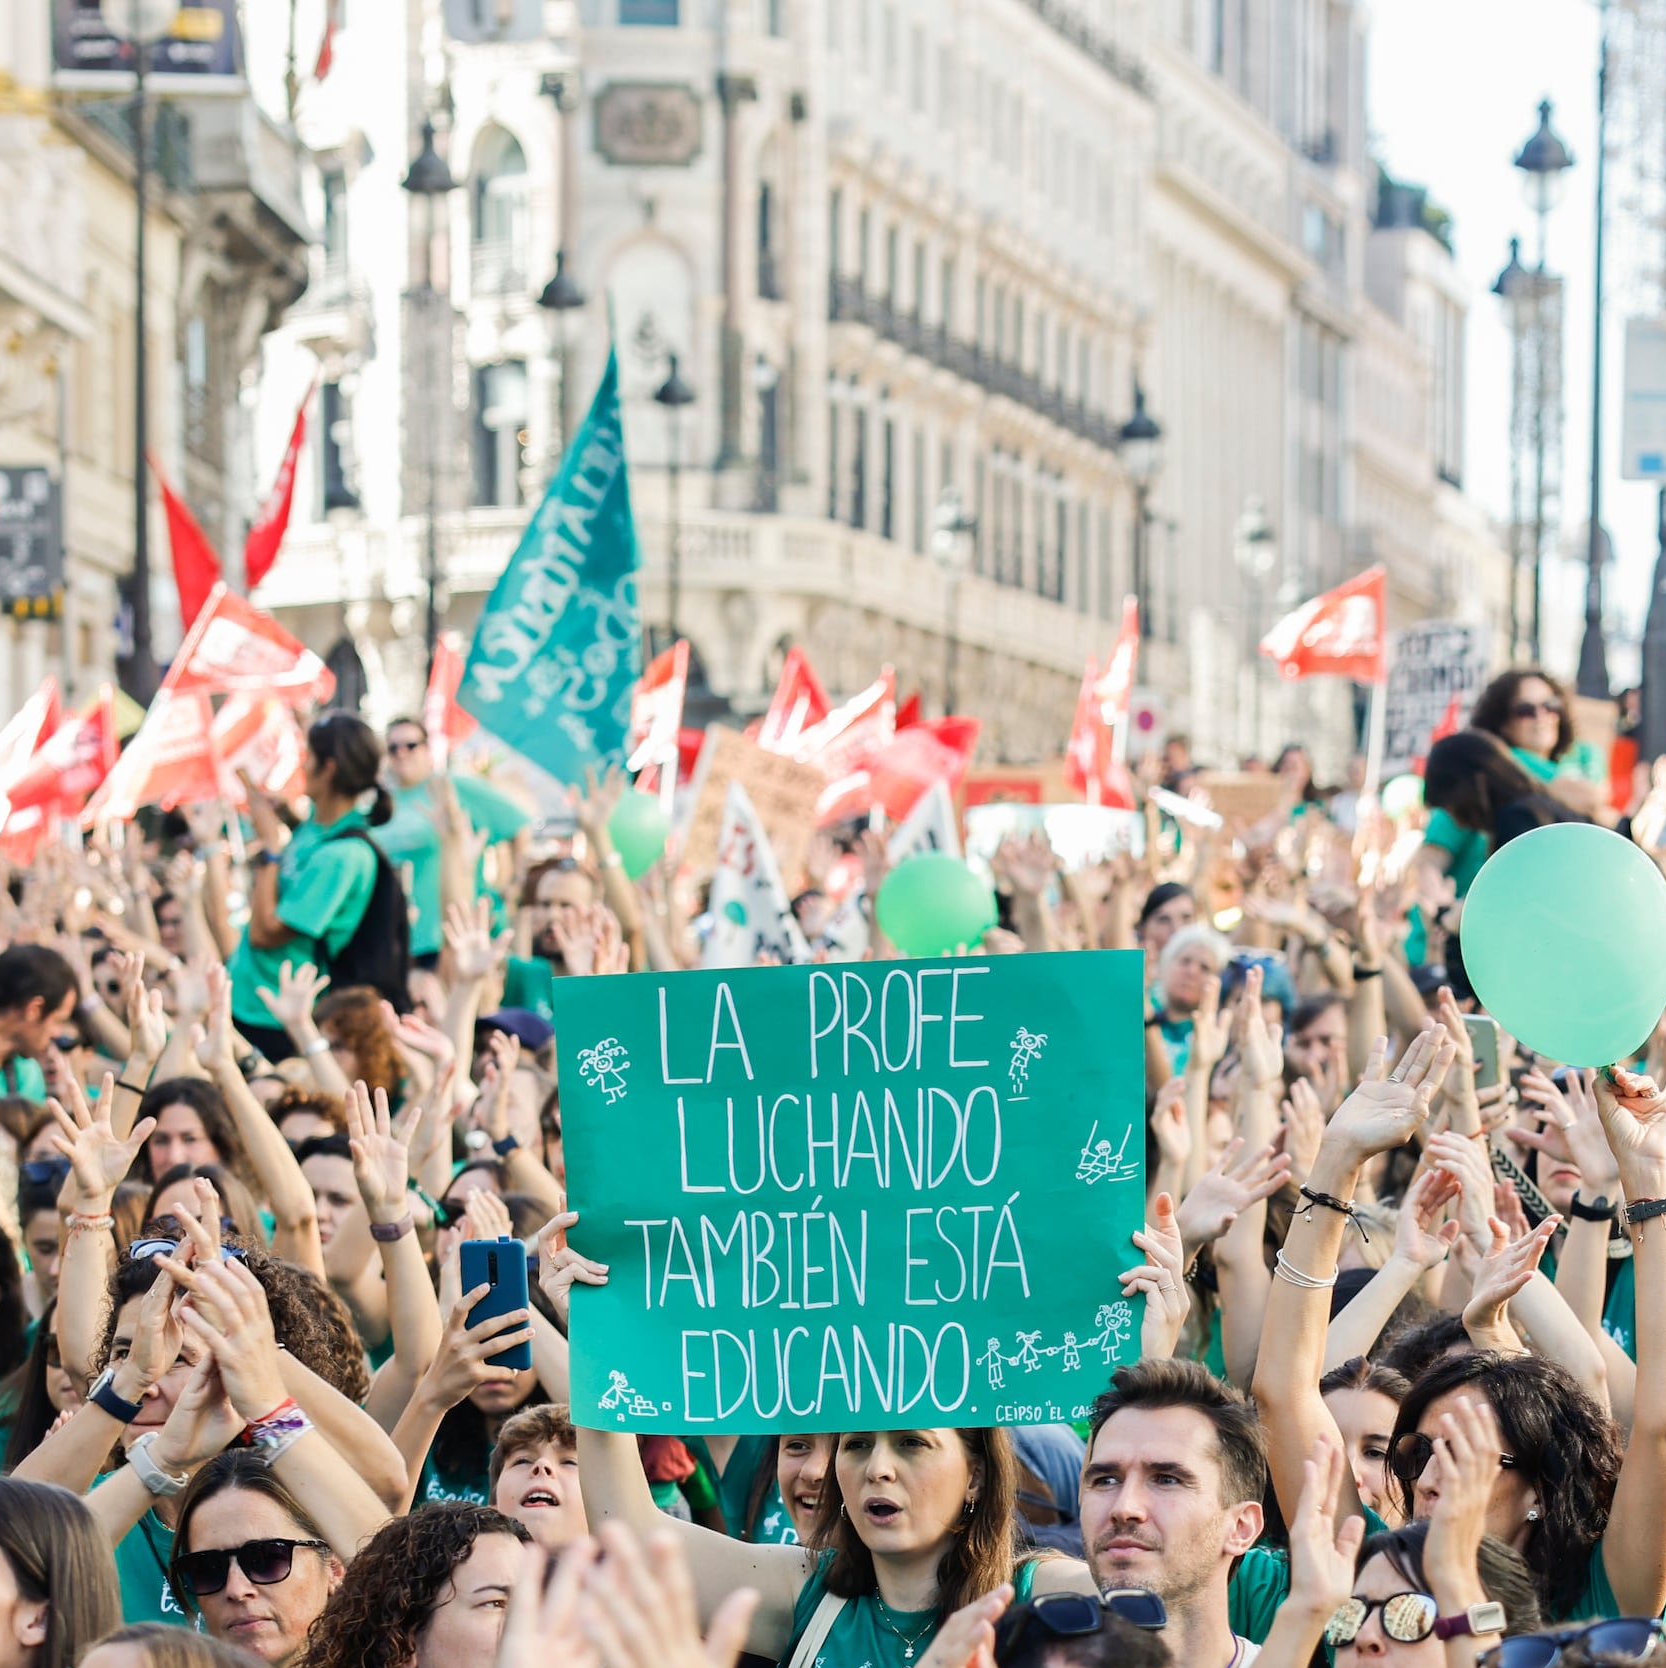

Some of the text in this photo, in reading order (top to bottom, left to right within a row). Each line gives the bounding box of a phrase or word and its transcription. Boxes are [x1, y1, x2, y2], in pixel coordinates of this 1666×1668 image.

[657, 966, 990, 1084] LA PROFE
[677, 1085, 1002, 1195] LUCHANDO
[623, 1190, 1031, 1311] TAMBIÉN ESTÁ
